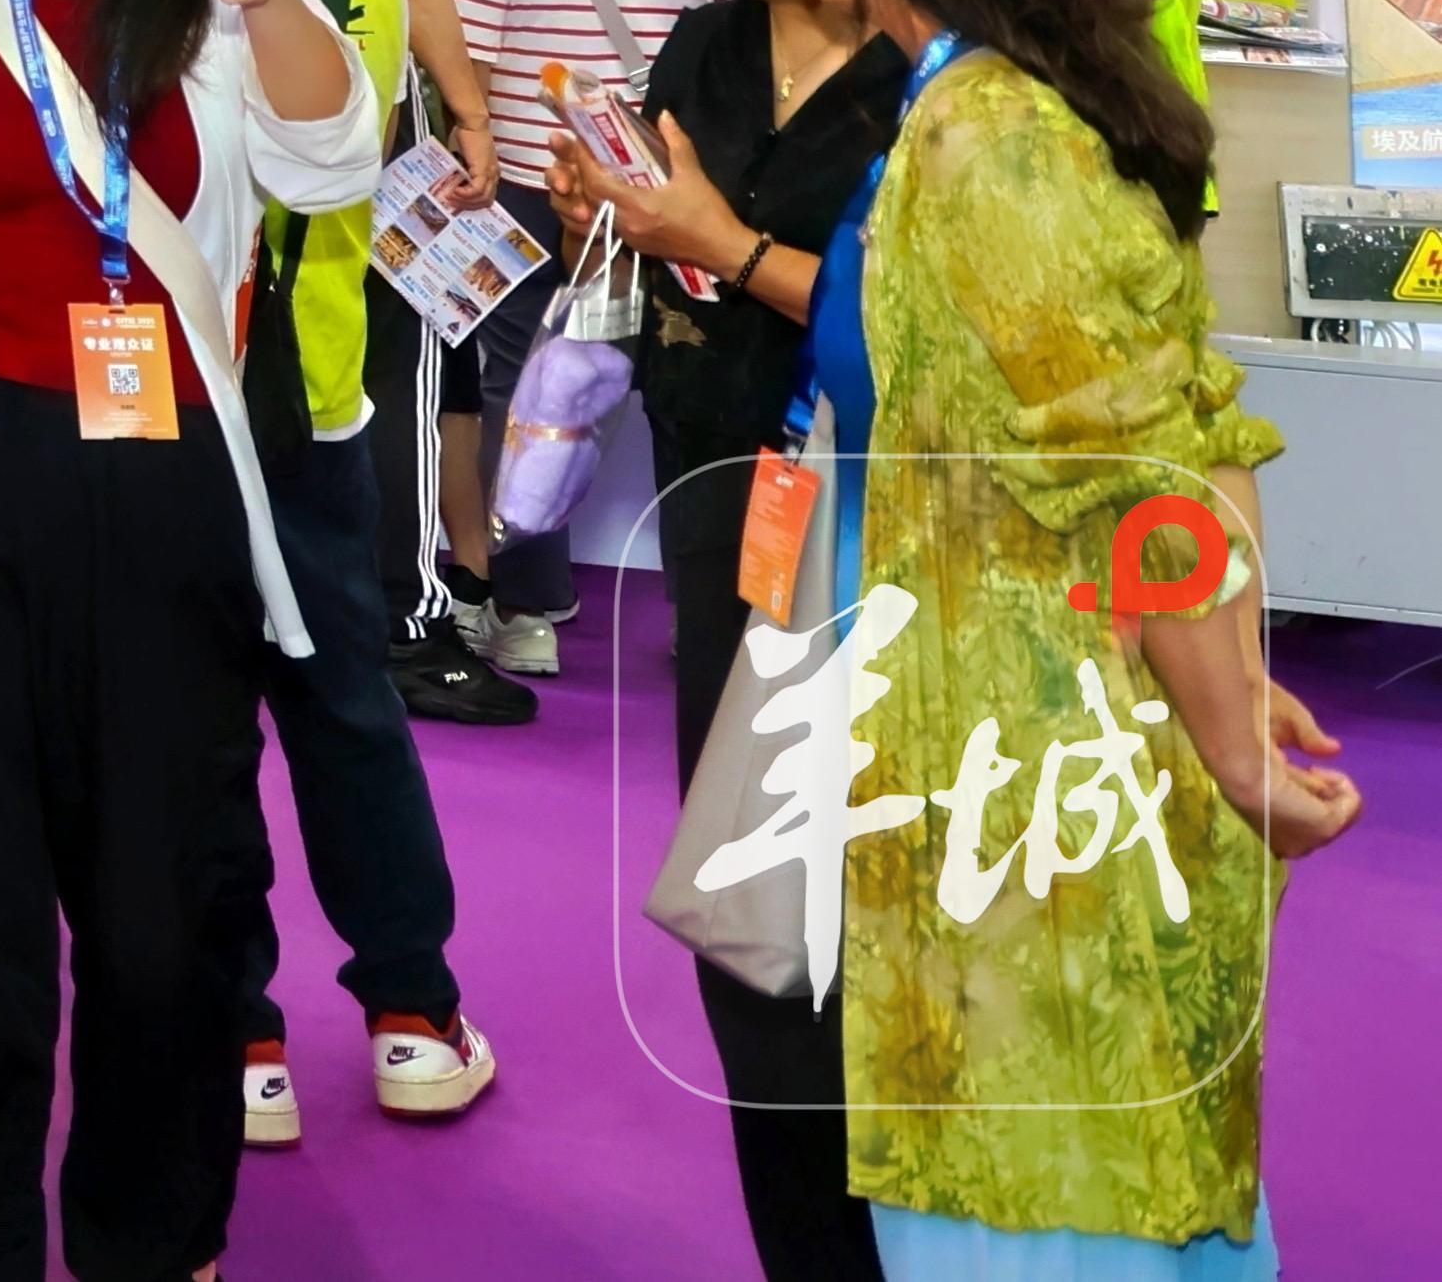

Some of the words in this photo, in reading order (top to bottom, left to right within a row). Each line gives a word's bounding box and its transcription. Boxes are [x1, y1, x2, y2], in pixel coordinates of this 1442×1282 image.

[83, 336, 155, 352] 专业观众证
[444, 671, 468, 684] FILA
[392, 1045, 416, 1058] NIKE
[265, 1077, 286, 1090] NIKE
